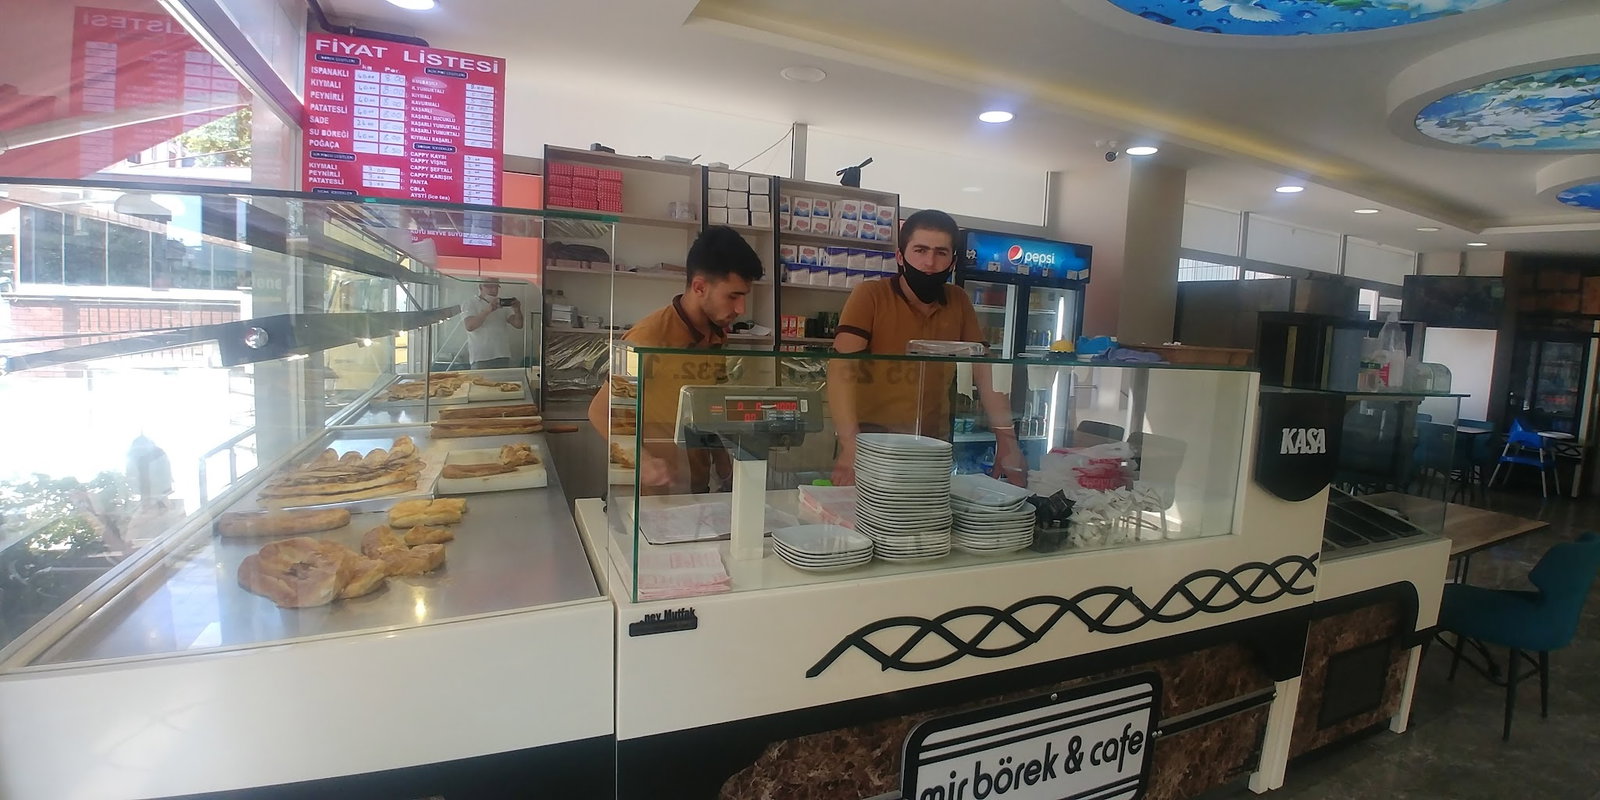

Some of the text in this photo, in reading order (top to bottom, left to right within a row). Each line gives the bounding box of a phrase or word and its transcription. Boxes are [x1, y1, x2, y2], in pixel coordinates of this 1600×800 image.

[315, 38, 389, 58] FİYAT
[403, 50, 498, 74] LİSTESİ
[310, 78, 341, 89] KIYMALI
[310, 91, 344, 101] PEYNİRLİ
[310, 103, 348, 114] PATATESLİ
[309, 115, 329, 125] SADE
[309, 128, 320, 136] SU
[308, 162, 338, 170] KIYMALI
[1024, 250, 1055, 266] pepsi
[1280, 428, 1326, 454] KASA
[973, 742, 1059, 800] börek
[1064, 735, 1084, 774] &
[1090, 723, 1143, 773] cafe
